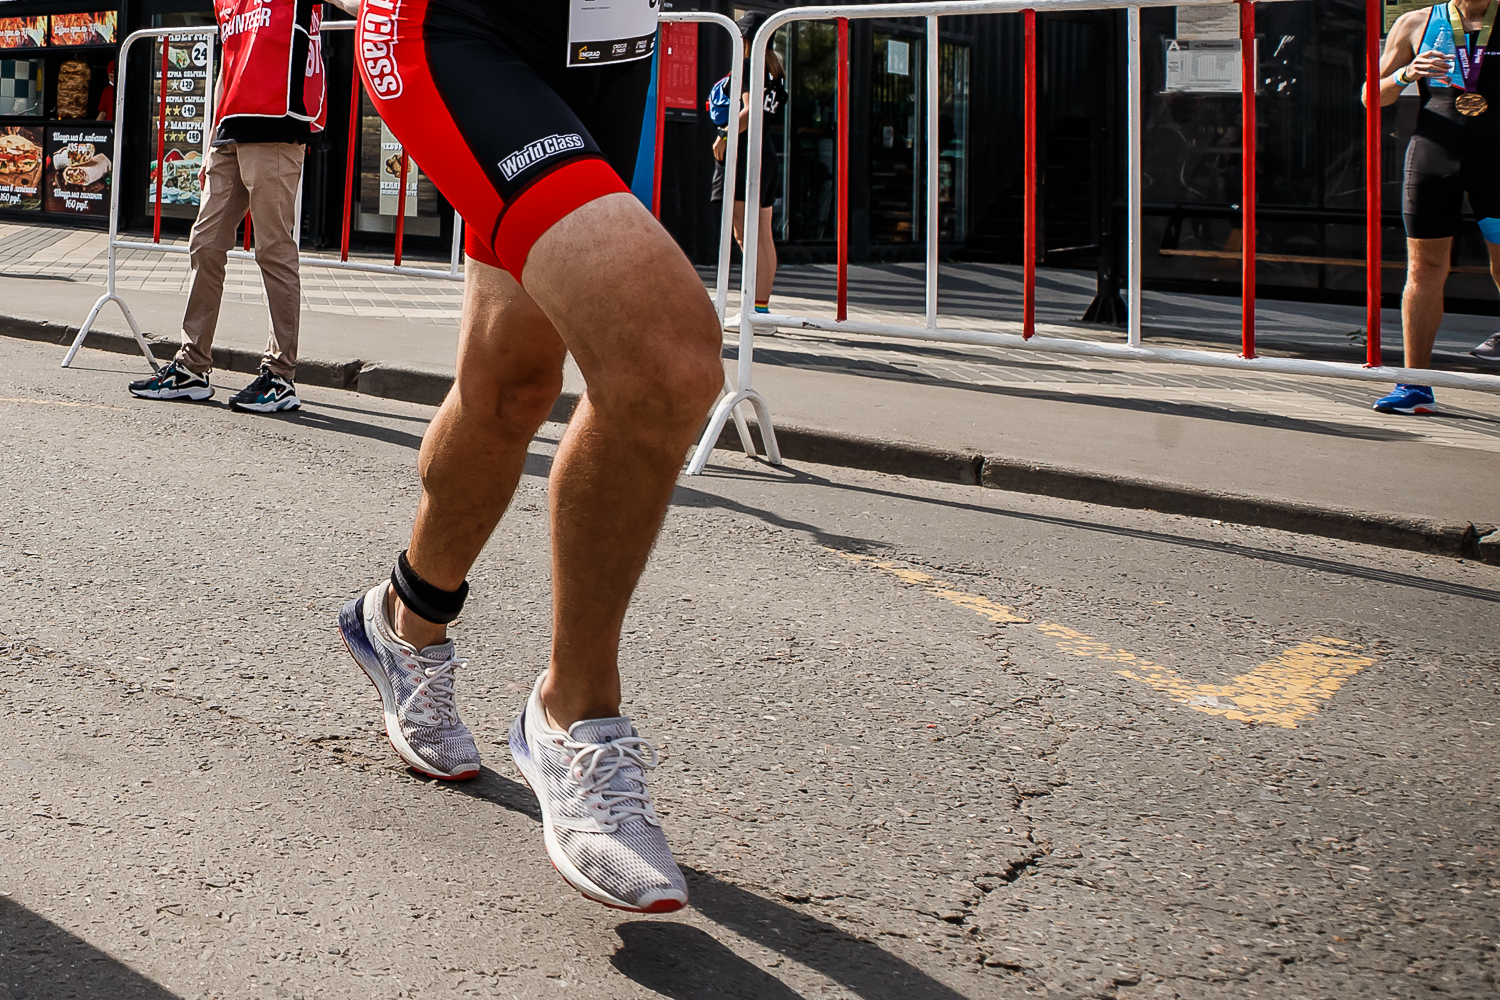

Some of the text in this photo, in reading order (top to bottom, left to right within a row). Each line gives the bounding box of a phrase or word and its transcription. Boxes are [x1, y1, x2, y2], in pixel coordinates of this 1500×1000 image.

[363, 12, 398, 93] Class
[53, 132, 78, 144] Шаурма
[502, 135, 582, 177] World Class
[54, 188, 79, 200] Шаурма
[65, 199, 76, 209] 160
